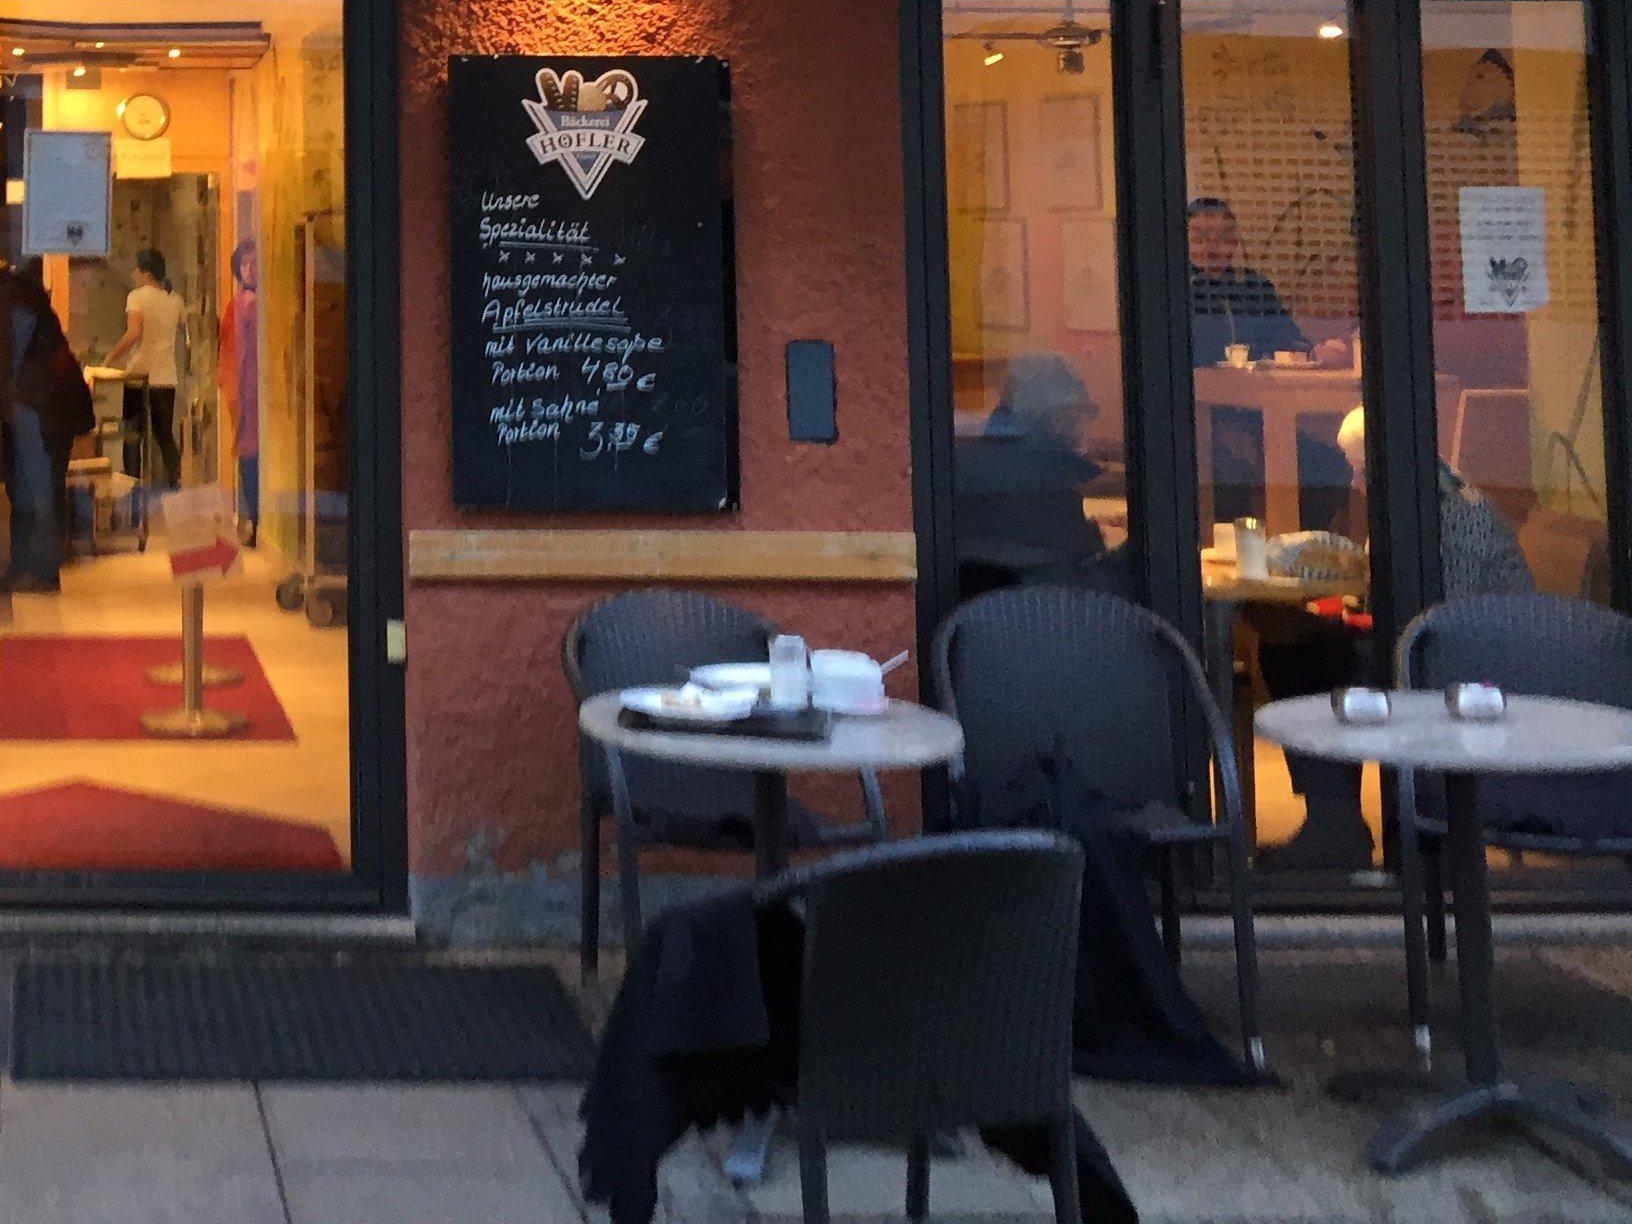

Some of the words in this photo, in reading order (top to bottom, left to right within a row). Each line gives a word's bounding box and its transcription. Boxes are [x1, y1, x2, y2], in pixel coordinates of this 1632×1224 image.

[561, 115, 610, 127] Bäckerei
[539, 132, 630, 155] HÖFLER
[480, 191, 541, 213] Unsere
[479, 217, 591, 248] Spezialität
[482, 271, 618, 298] hausgemachter
[481, 296, 625, 328] Apfelstrudel
[484, 334, 516, 358] mit
[491, 360, 560, 386] Portion
[489, 397, 526, 425] mit
[497, 418, 561, 447] Portion
